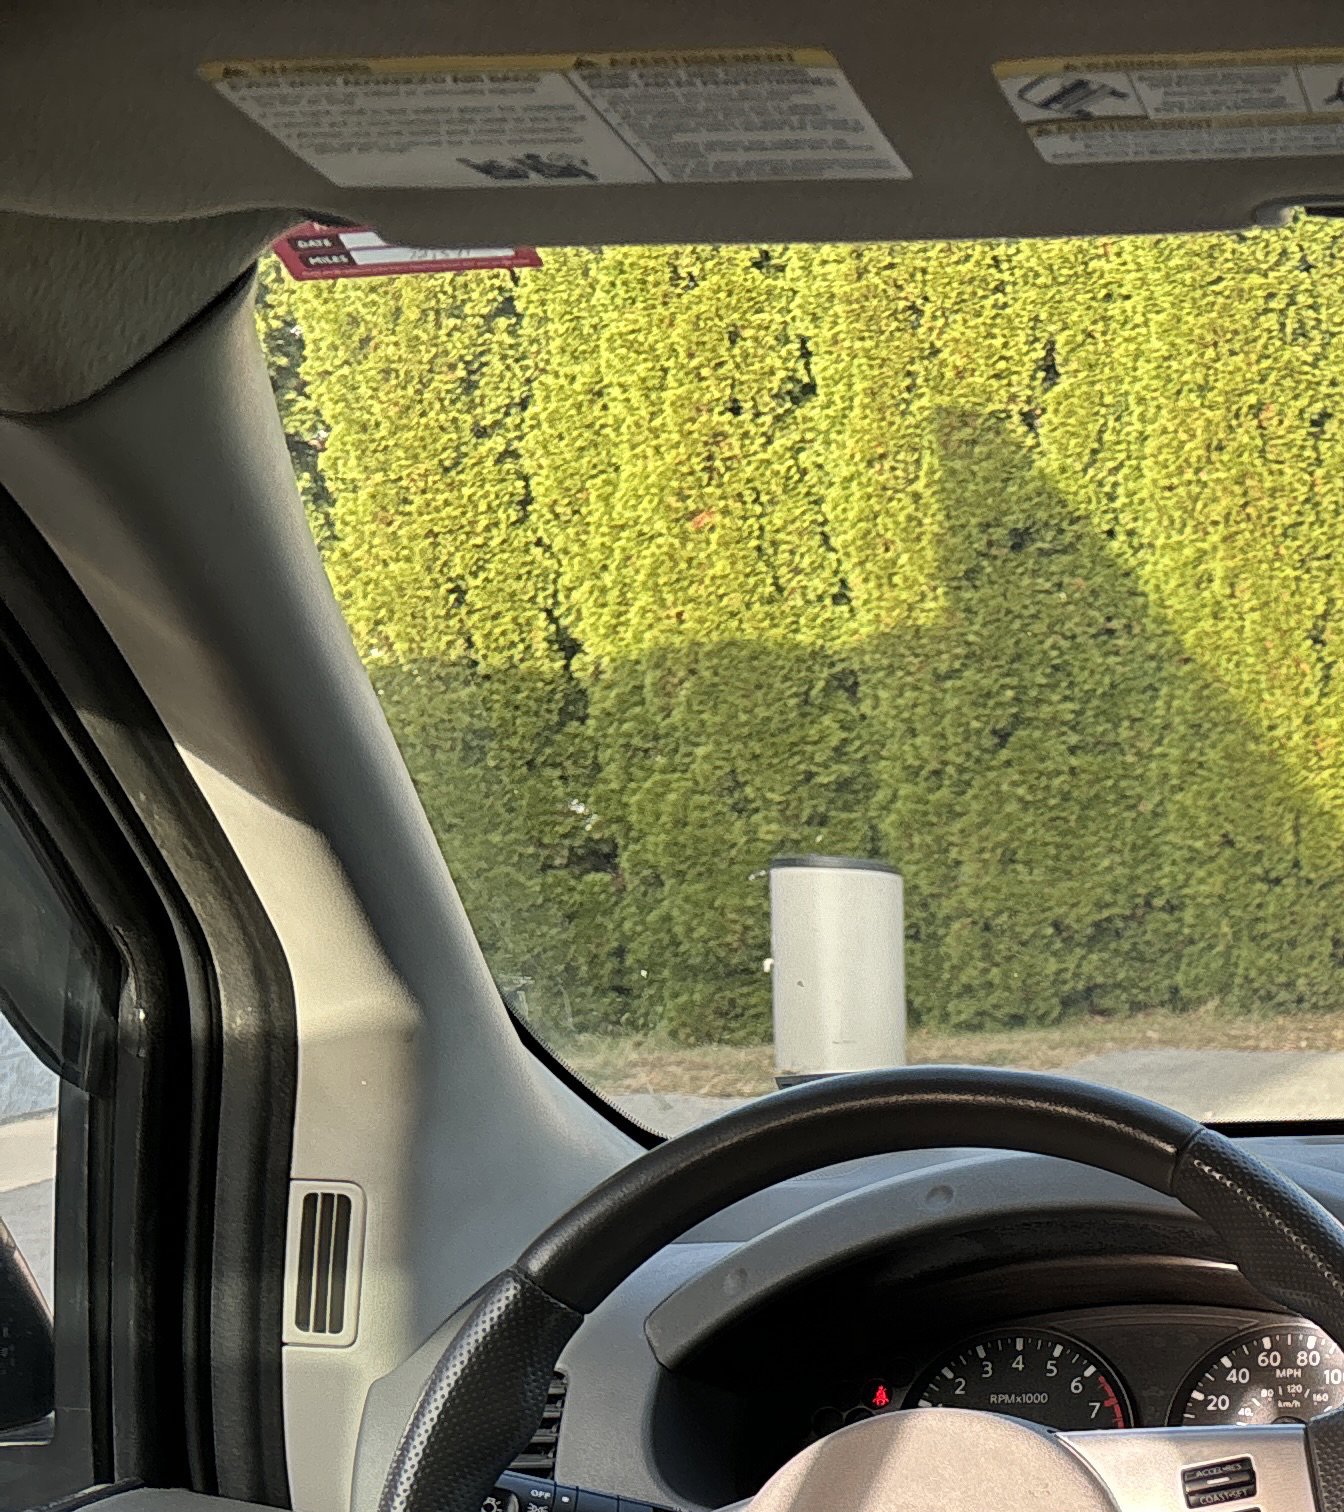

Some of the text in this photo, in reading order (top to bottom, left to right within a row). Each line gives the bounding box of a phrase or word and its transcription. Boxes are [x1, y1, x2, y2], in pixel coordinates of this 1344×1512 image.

[1011, 1354, 1025, 1371] 4
[1257, 1351, 1281, 1367] 60
[1296, 1350, 1321, 1367] 80
[981, 1361, 993, 1378] 3
[1046, 1360, 1058, 1377] 5
[1225, 1367, 1250, 1384] 40
[1275, 1368, 1302, 1378] MPH
[954, 1378, 966, 1395] 2
[1070, 1377, 1083, 1394] 6
[1286, 1384, 1303, 1393] 120
[989, 1392, 1048, 1404] RPMx1000
[1206, 1394, 1230, 1411] 20
[1088, 1402, 1101, 1419] 7
[530, 1488, 551, 1499] OFF
